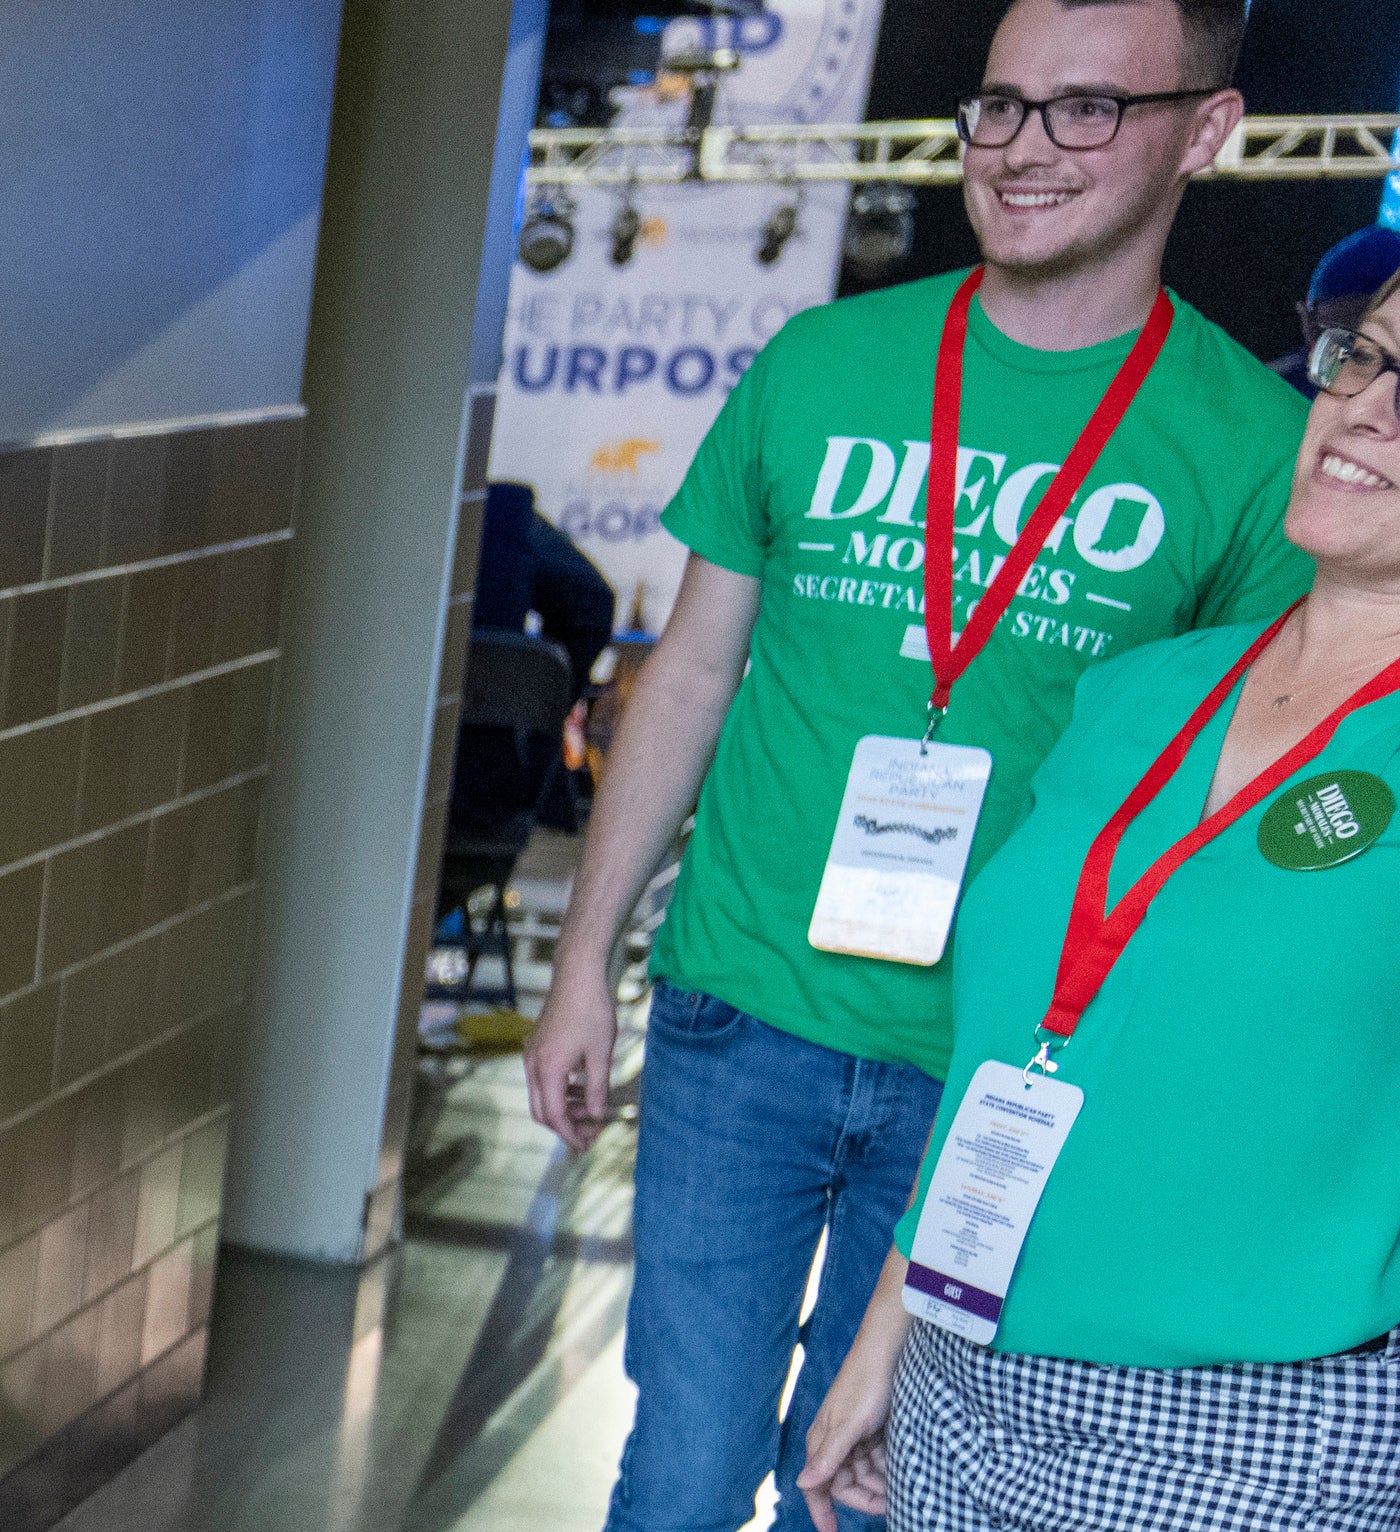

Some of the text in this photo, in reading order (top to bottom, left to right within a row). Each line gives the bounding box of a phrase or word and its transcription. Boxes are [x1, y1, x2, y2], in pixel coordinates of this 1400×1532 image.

[569, 293, 741, 338] PARTY
[804, 436, 1165, 572] DIEGO
[841, 530, 1076, 606] MOAES
[793, 572, 962, 615] SECRETA
[1310, 802, 1333, 837] MORALES
[1317, 783, 1359, 839] DIEGO
